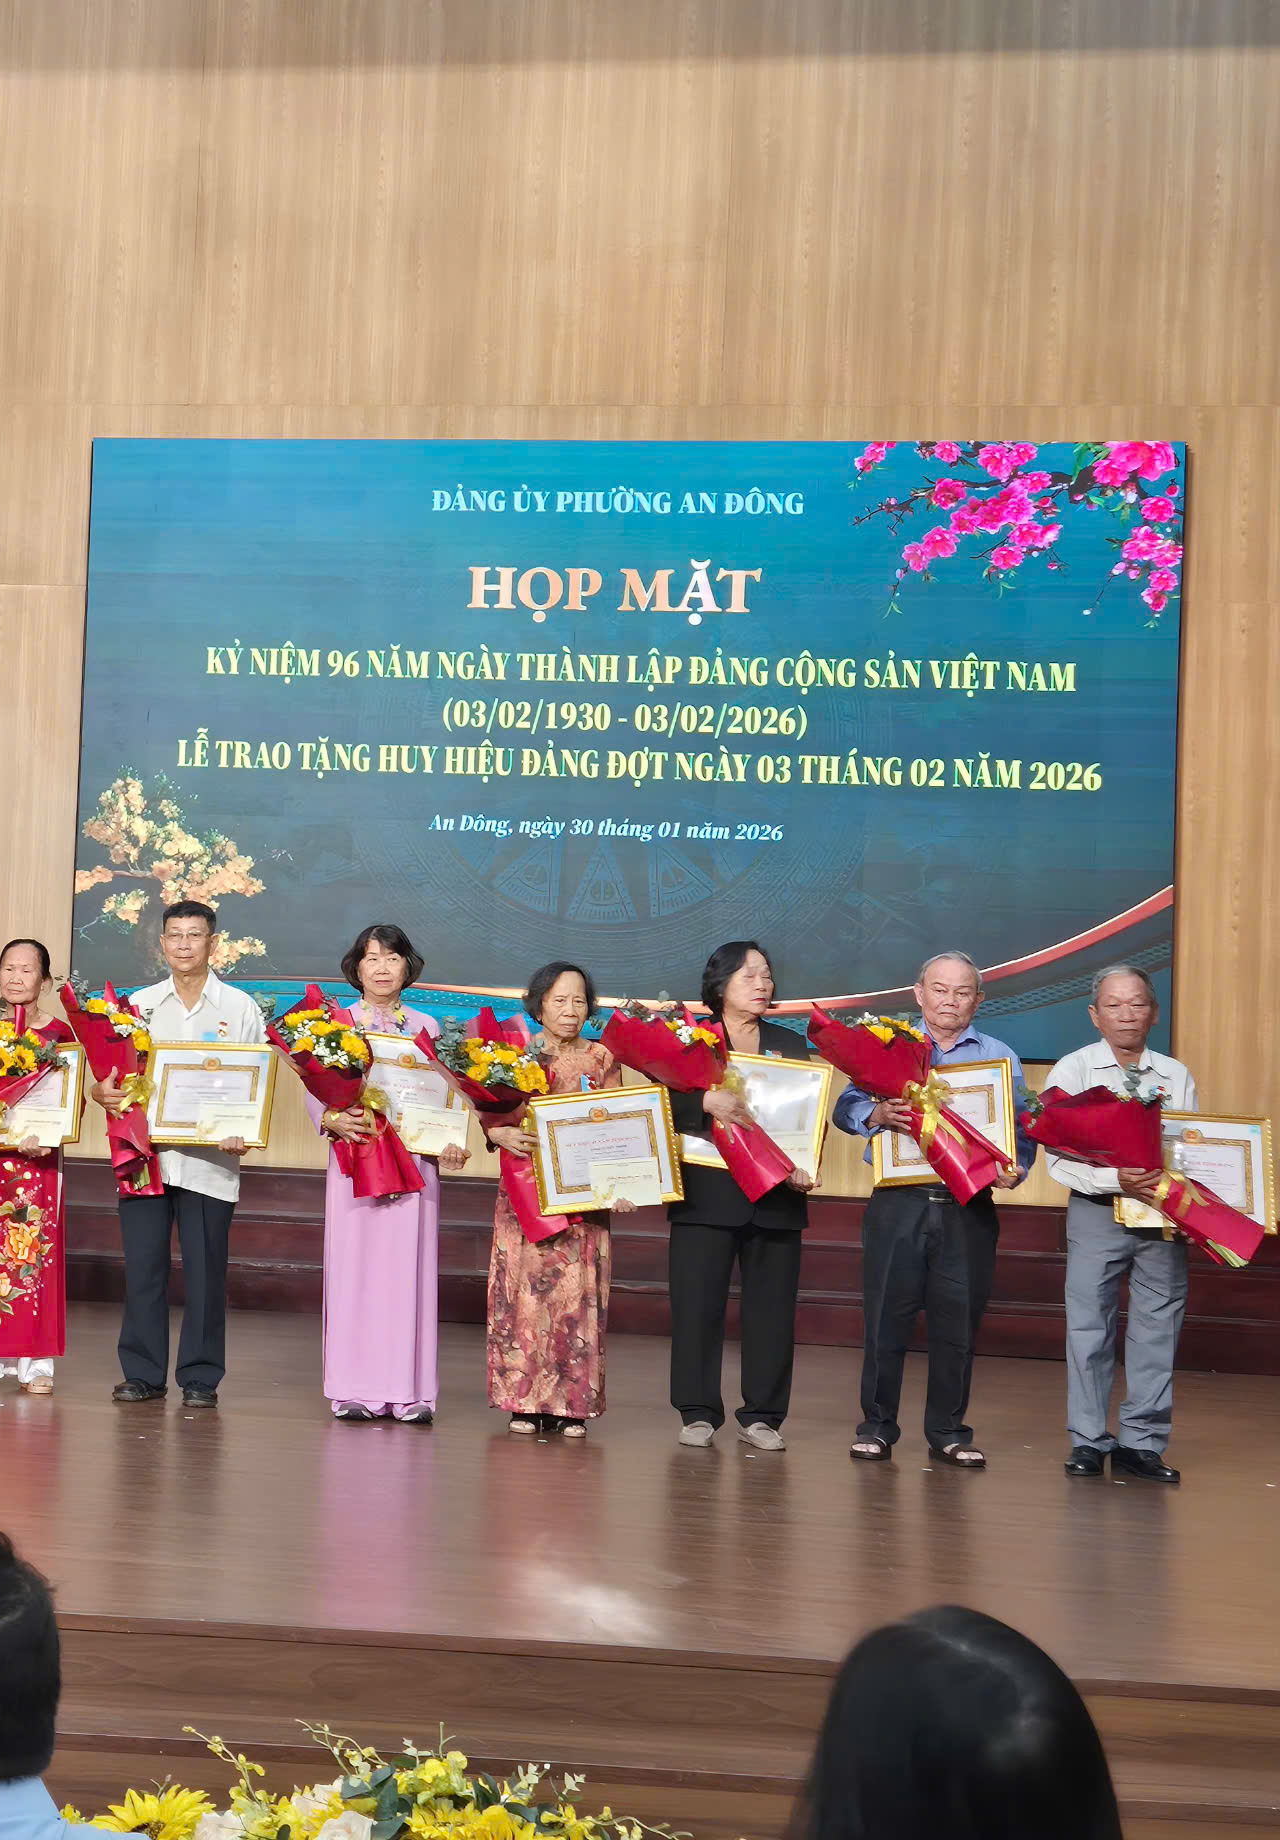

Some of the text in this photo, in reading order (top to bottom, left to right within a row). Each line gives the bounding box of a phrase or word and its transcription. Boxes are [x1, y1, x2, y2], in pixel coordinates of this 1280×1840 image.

[431, 483, 804, 515] ĐẢNG ỦY PHƯỜNG AN ĐÔNG
[466, 558, 763, 626] HỌP MẶT
[206, 638, 1077, 698] KỶ NIỆM 96 NĂM NGÀY THÀNH LẬP ĐẢNG CỘNG SẢN VIỆT NAM
[442, 697, 612, 735] (03/02/1930
[634, 702, 808, 741] 03/02/2026)
[176, 727, 1102, 791] LỄ TRAO TẶNG HUY HIỆU ĐẢNG ĐỢT NGÀY 03 THÁNG 02 NĂM 2026
[428, 814, 455, 831] An
[518, 815, 566, 840] ngày
[569, 818, 594, 835] 30
[597, 818, 655, 842] tháng
[657, 821, 681, 838] 01
[686, 821, 730, 840] năm
[734, 823, 785, 841] 2026
